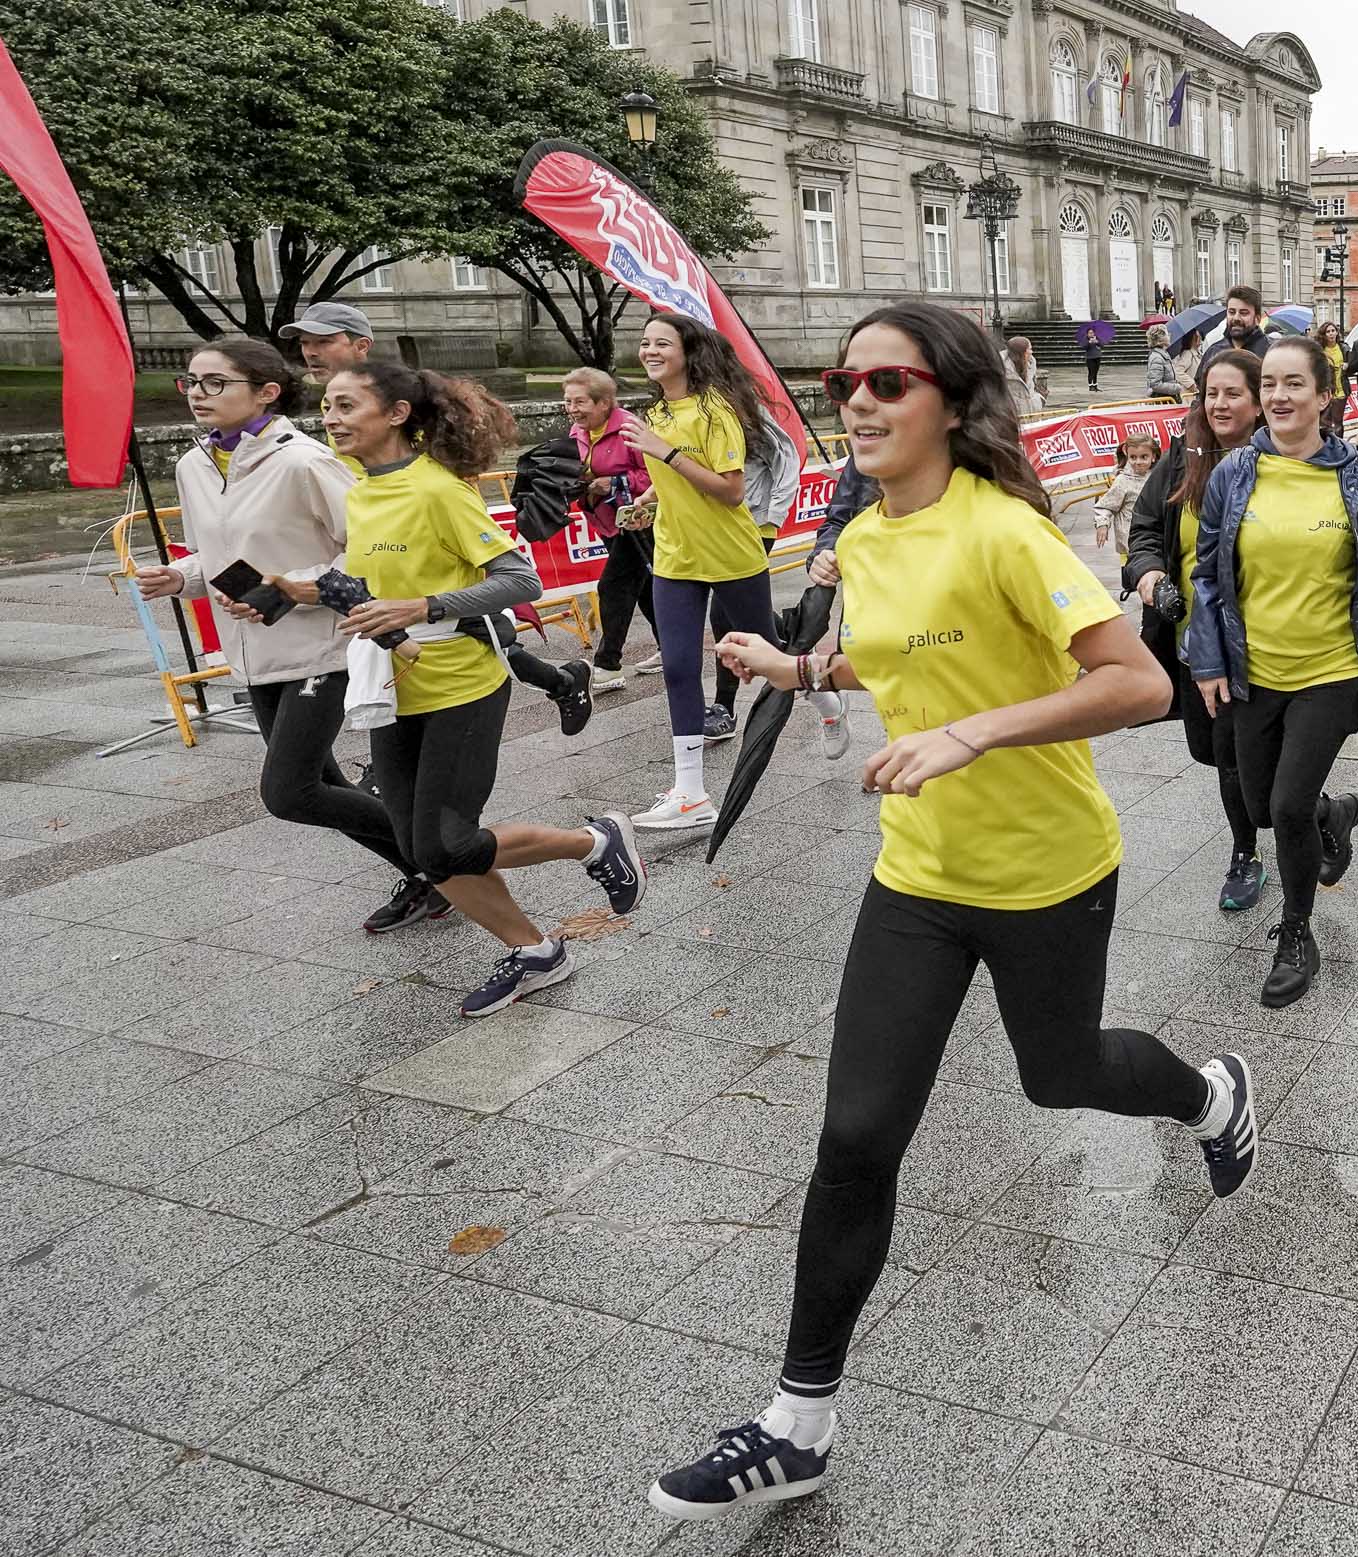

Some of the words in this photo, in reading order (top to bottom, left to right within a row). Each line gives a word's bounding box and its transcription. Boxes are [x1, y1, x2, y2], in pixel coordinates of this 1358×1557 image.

[1037, 433, 1075, 457] FROIZ
[1083, 427, 1118, 446] FROIZ
[1308, 520, 1350, 531] galicia
[364, 541, 407, 556] galicia
[900, 629, 964, 654] galicia
